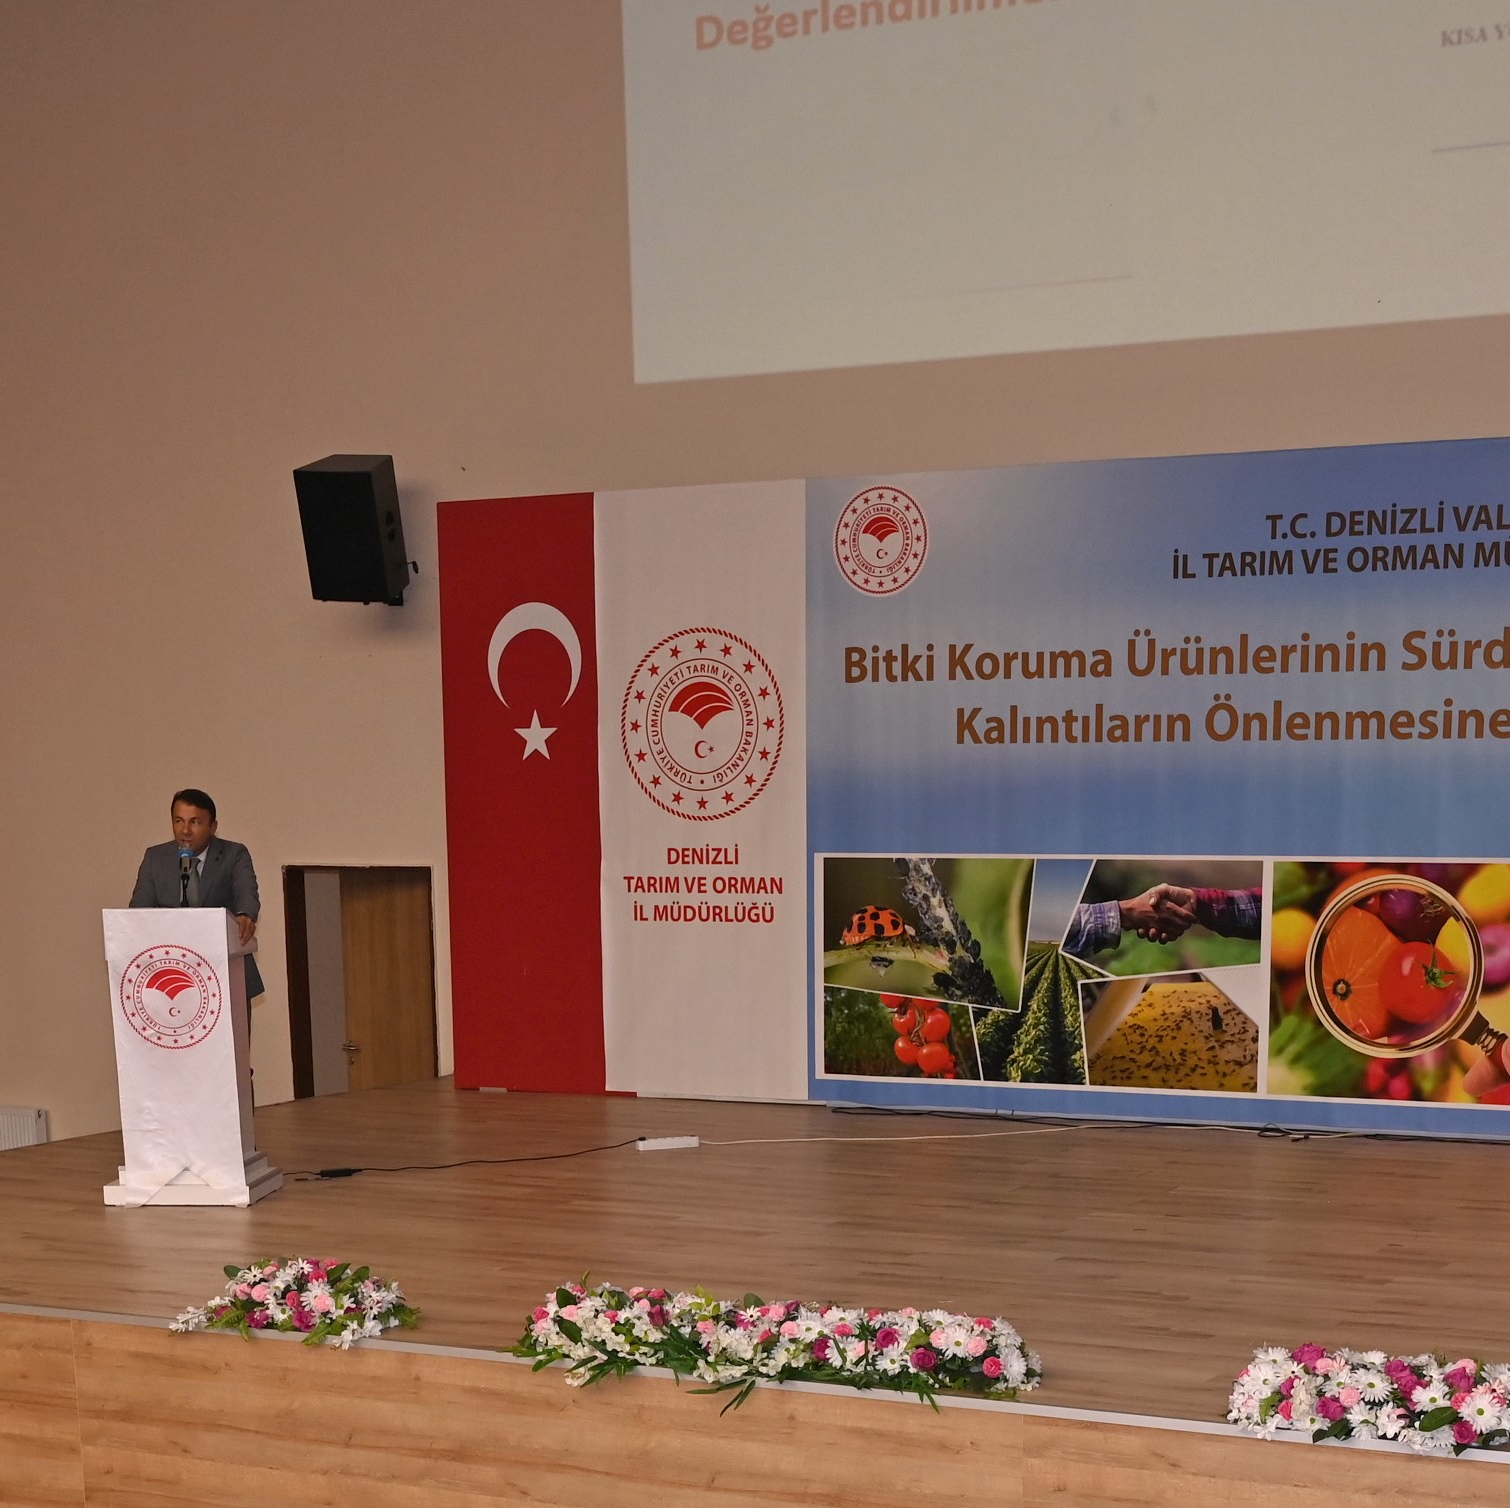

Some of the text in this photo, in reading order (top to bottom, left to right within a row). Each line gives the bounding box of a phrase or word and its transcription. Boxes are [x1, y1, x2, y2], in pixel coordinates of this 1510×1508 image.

[1441, 26, 1488, 47] KISA
[1265, 513, 1317, 540] T.C.
[1325, 500, 1445, 538] DENİZLİ
[1172, 547, 1197, 580] İL
[1202, 549, 1294, 578] TARIM
[1301, 546, 1339, 574] VE
[1346, 543, 1465, 572] ORMAN
[844, 643, 935, 684] Bitki
[947, 643, 1113, 681] Koruma
[1126, 628, 1387, 677] Ürünlerinin
[651, 663, 754, 785] TÜRKİYE CUMHURİYETİ TARIM VE ORMAN BAKANLIĞI
[955, 703, 1191, 745] Kalıntıların
[667, 843, 739, 865] DENİZLİ
[623, 876, 784, 895] TARIM VE ORMAN
[633, 900, 775, 923] İL MÜDÜRLÜĞÜ
